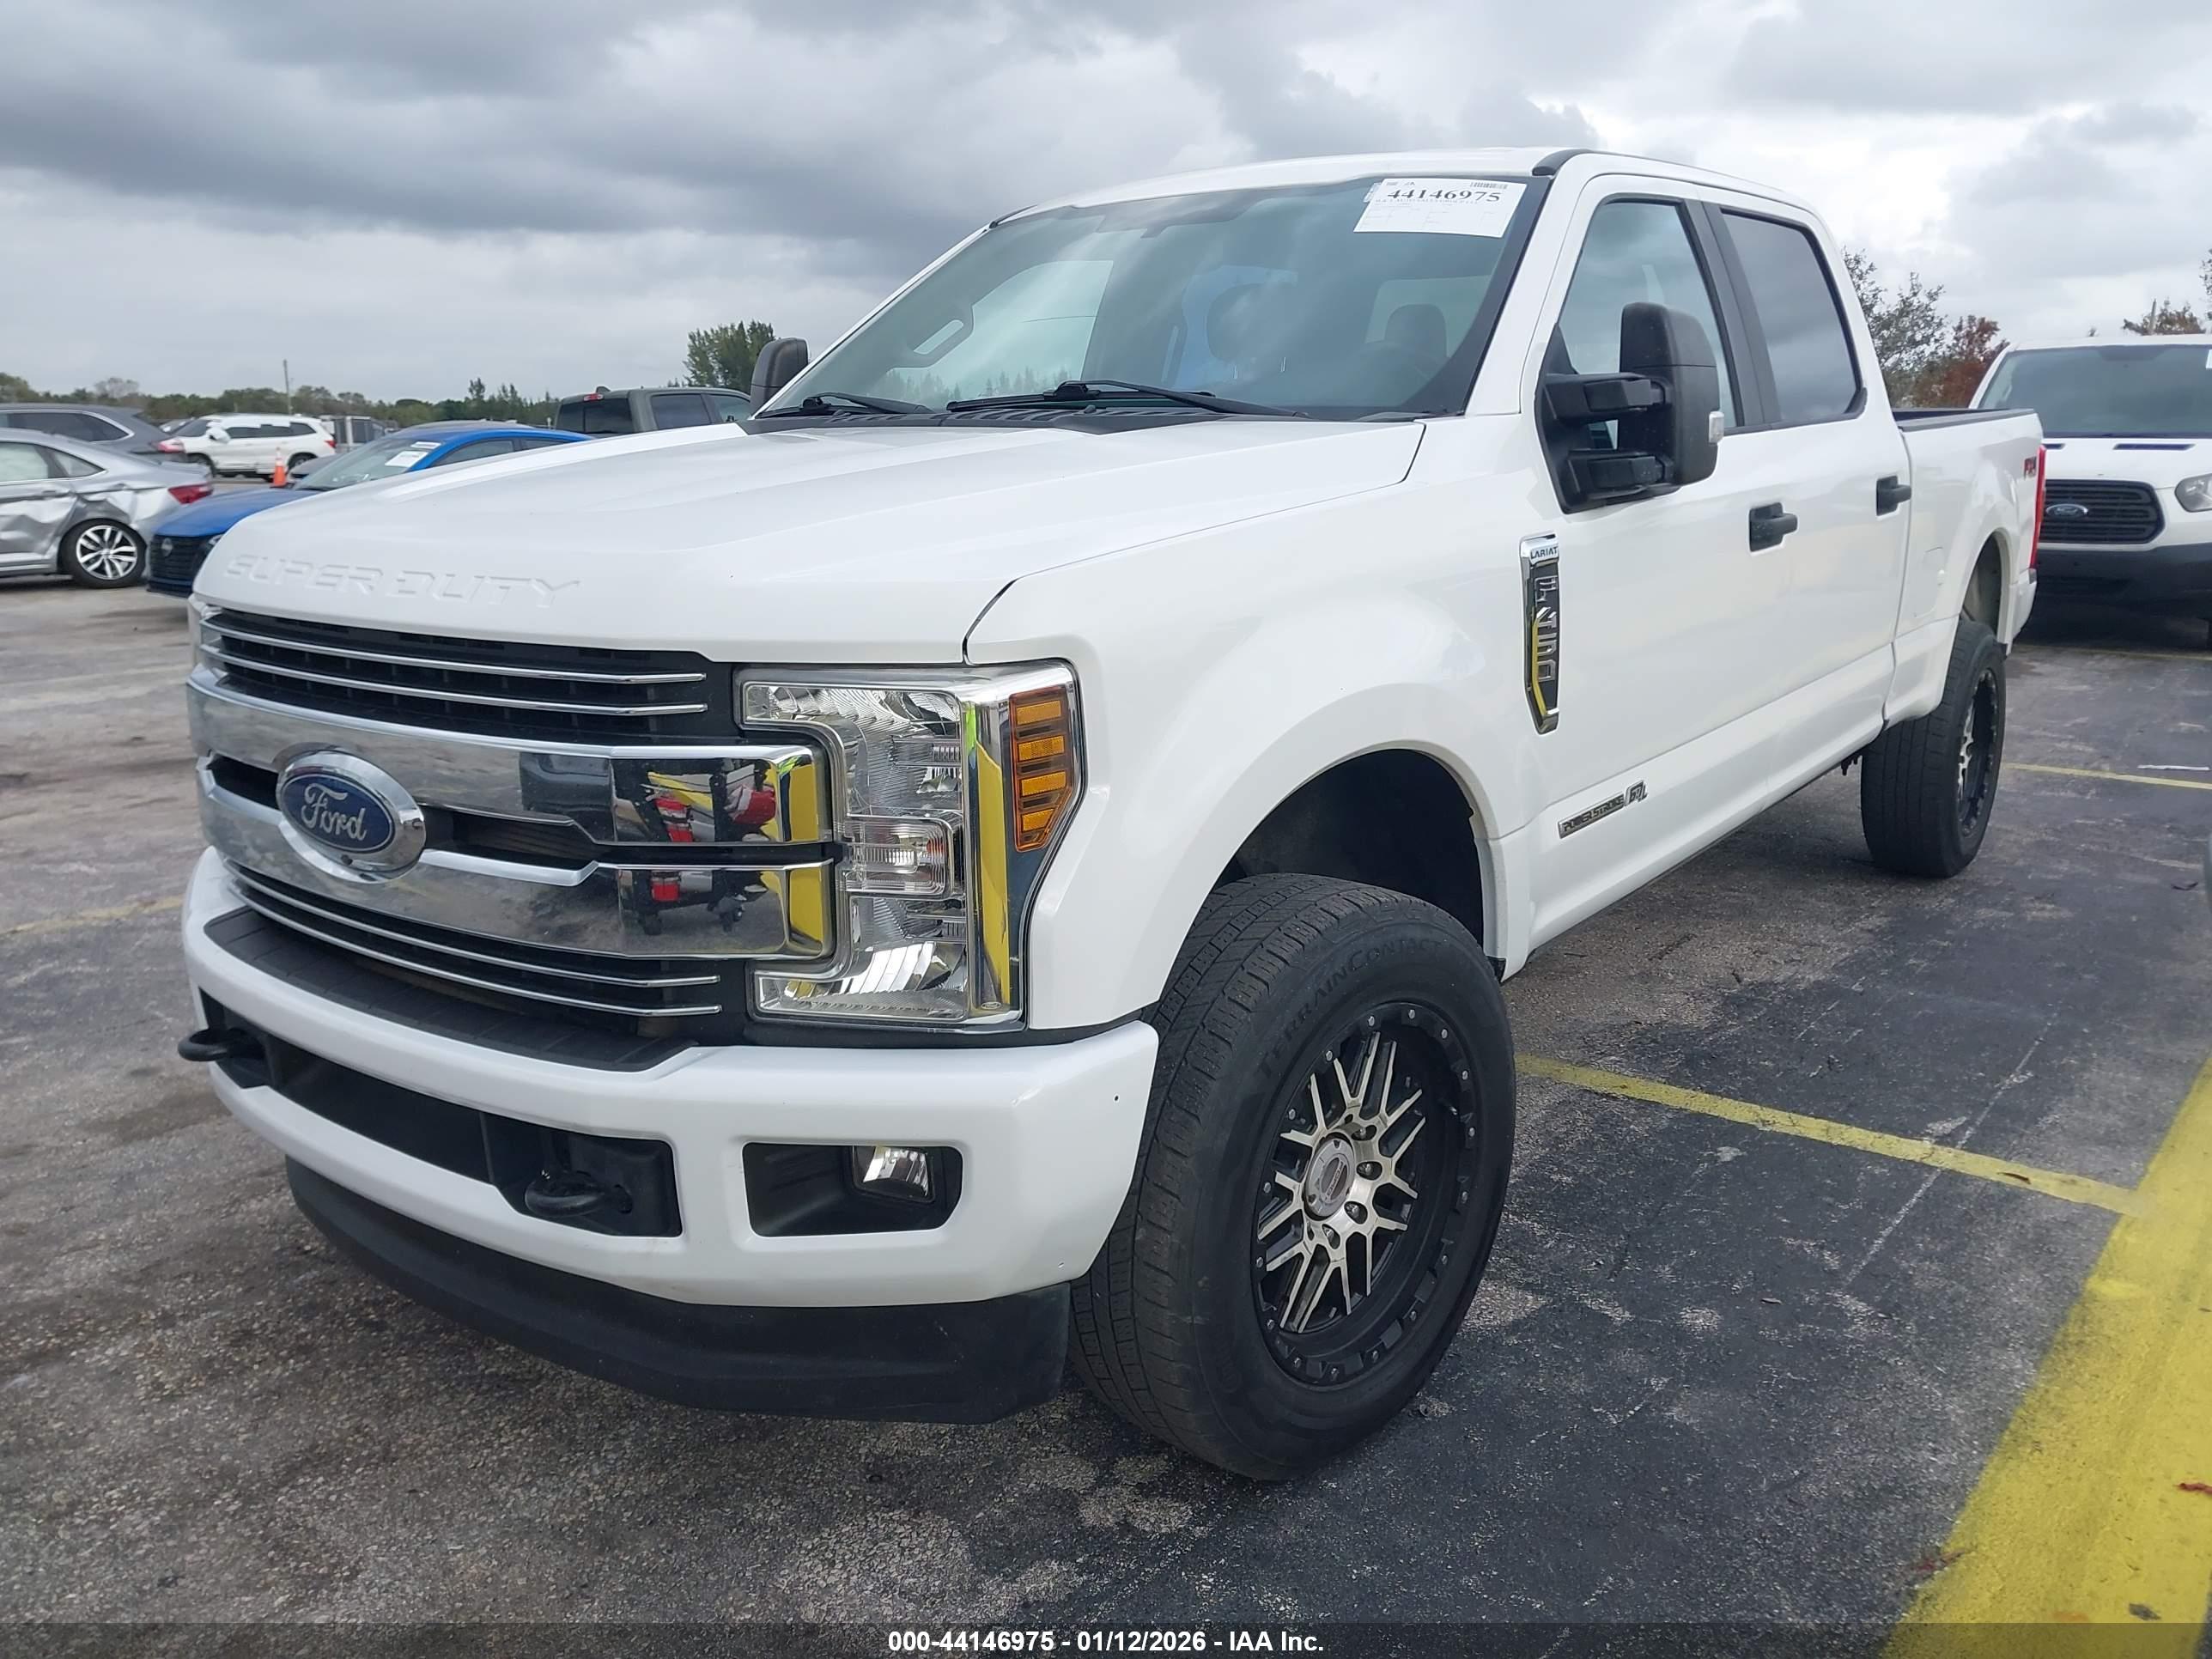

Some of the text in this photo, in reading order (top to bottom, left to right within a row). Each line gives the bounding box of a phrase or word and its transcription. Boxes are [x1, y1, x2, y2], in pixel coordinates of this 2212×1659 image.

[1387, 189, 1502, 202] 44146975
[1530, 546, 1559, 558] LARIAT
[225, 554, 581, 608] SUPER DUTY
[301, 782, 368, 842] Ford
